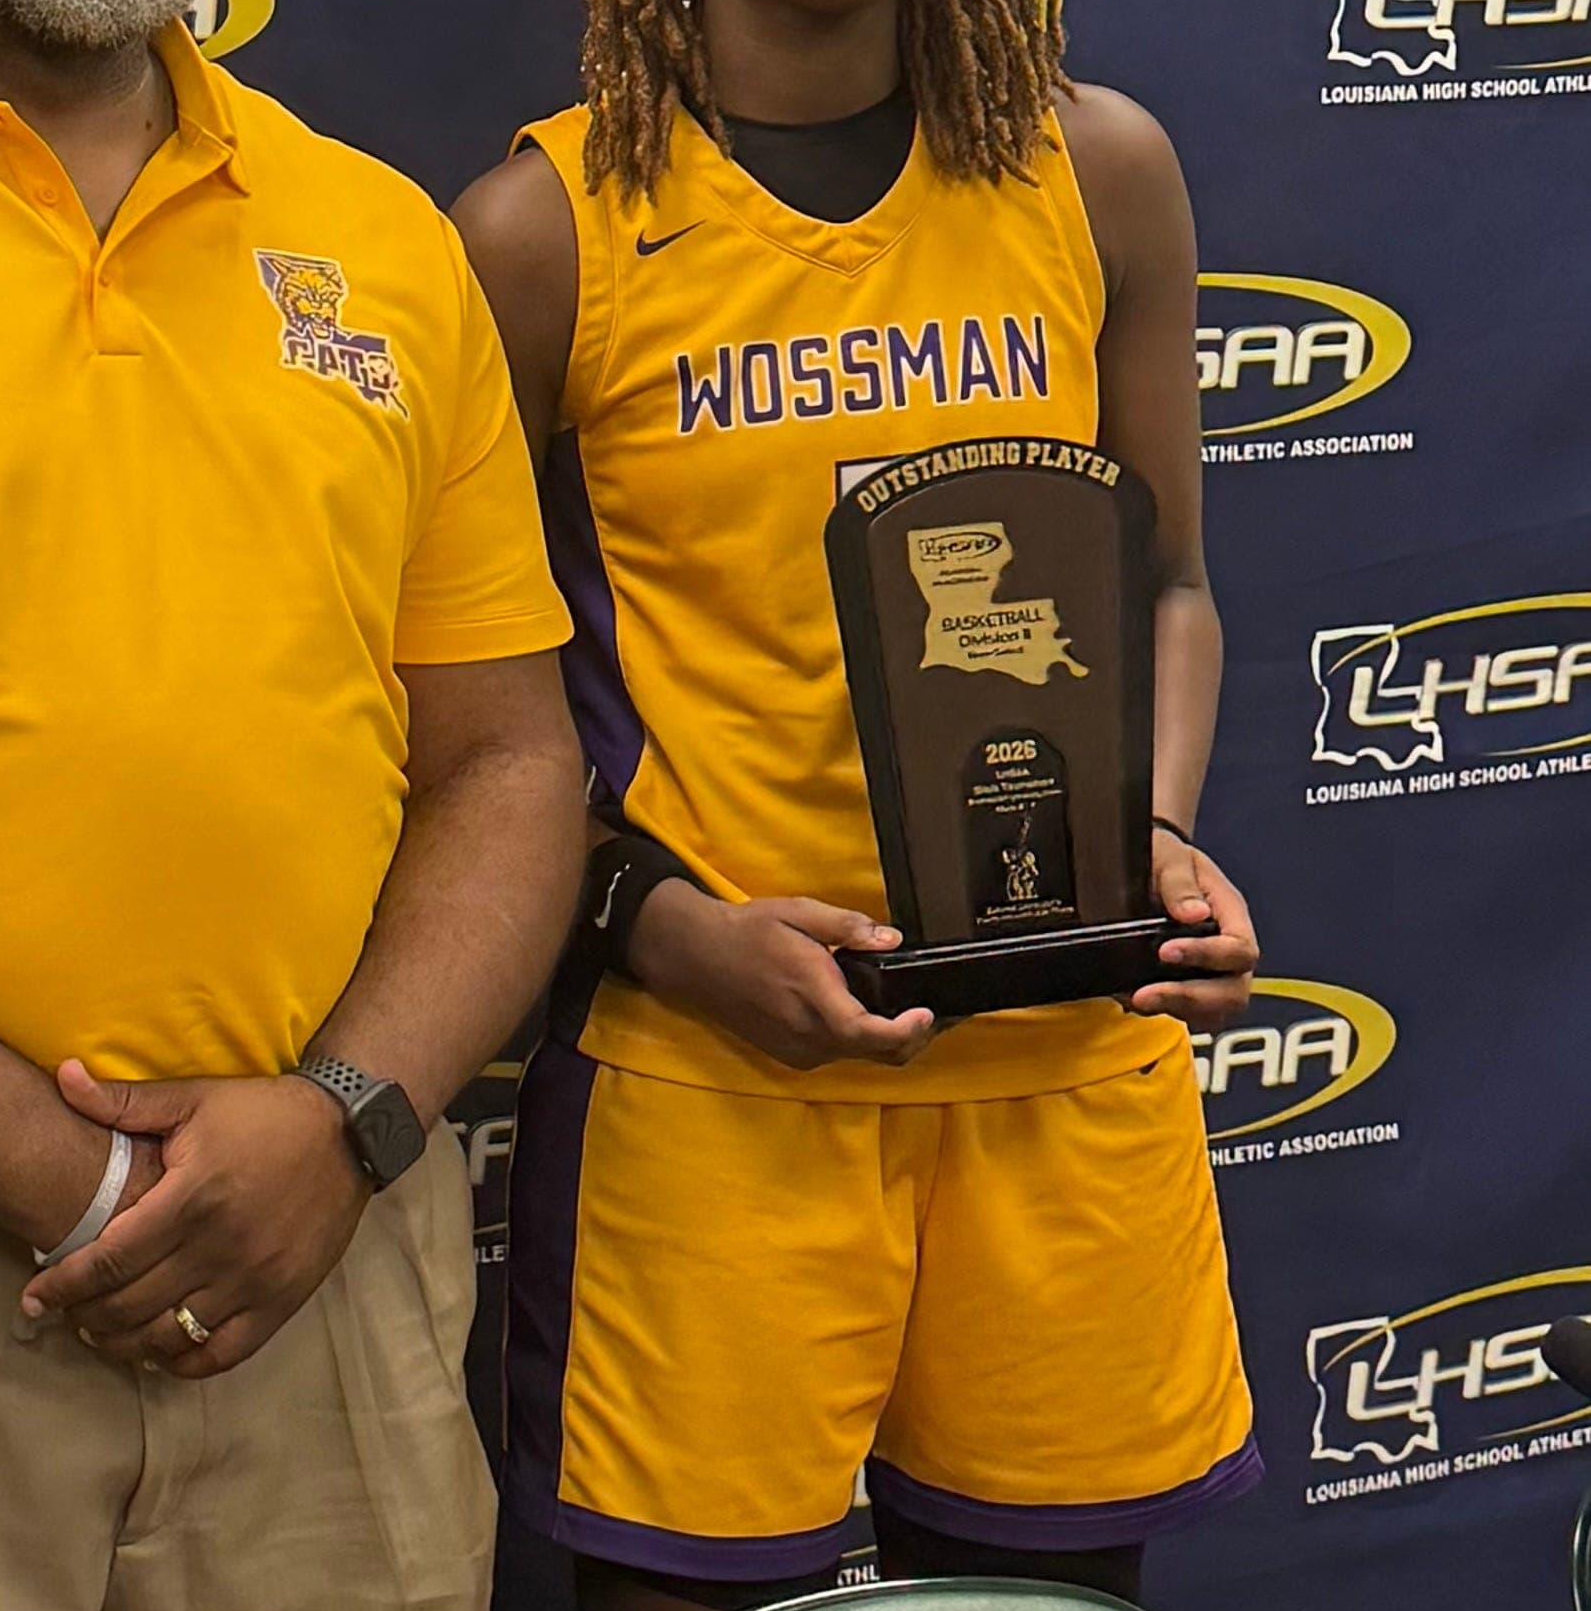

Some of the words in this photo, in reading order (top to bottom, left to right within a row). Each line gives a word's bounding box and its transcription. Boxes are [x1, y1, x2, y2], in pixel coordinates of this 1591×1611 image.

[1321, 84, 1419, 105] LOUISIANA
[1422, 82, 1467, 100] HIGH
[1470, 78, 1541, 98] SCHOOL
[283, 338, 400, 390] CATS
[675, 314, 1051, 434] WOSSMAN
[1290, 432, 1413, 458] ASSOCIATION
[857, 441, 1021, 513] OUTSTANDING
[1026, 441, 1121, 487] PLAYER
[985, 739, 1038, 765] 2026
[1306, 778, 1405, 805] LOUISIANA
[1408, 772, 1455, 794] HIGH
[1459, 762, 1533, 787] SCHOOL
[1209, 1141, 1275, 1167] HLETIC
[1279, 1122, 1399, 1156] ASSOCIATION
[1347, 1322, 1560, 1422] LHS
[1306, 1470, 1402, 1504] LOUISIANA
[1405, 1459, 1450, 1484] HIGH
[1453, 1443, 1524, 1473] SCHOOL
